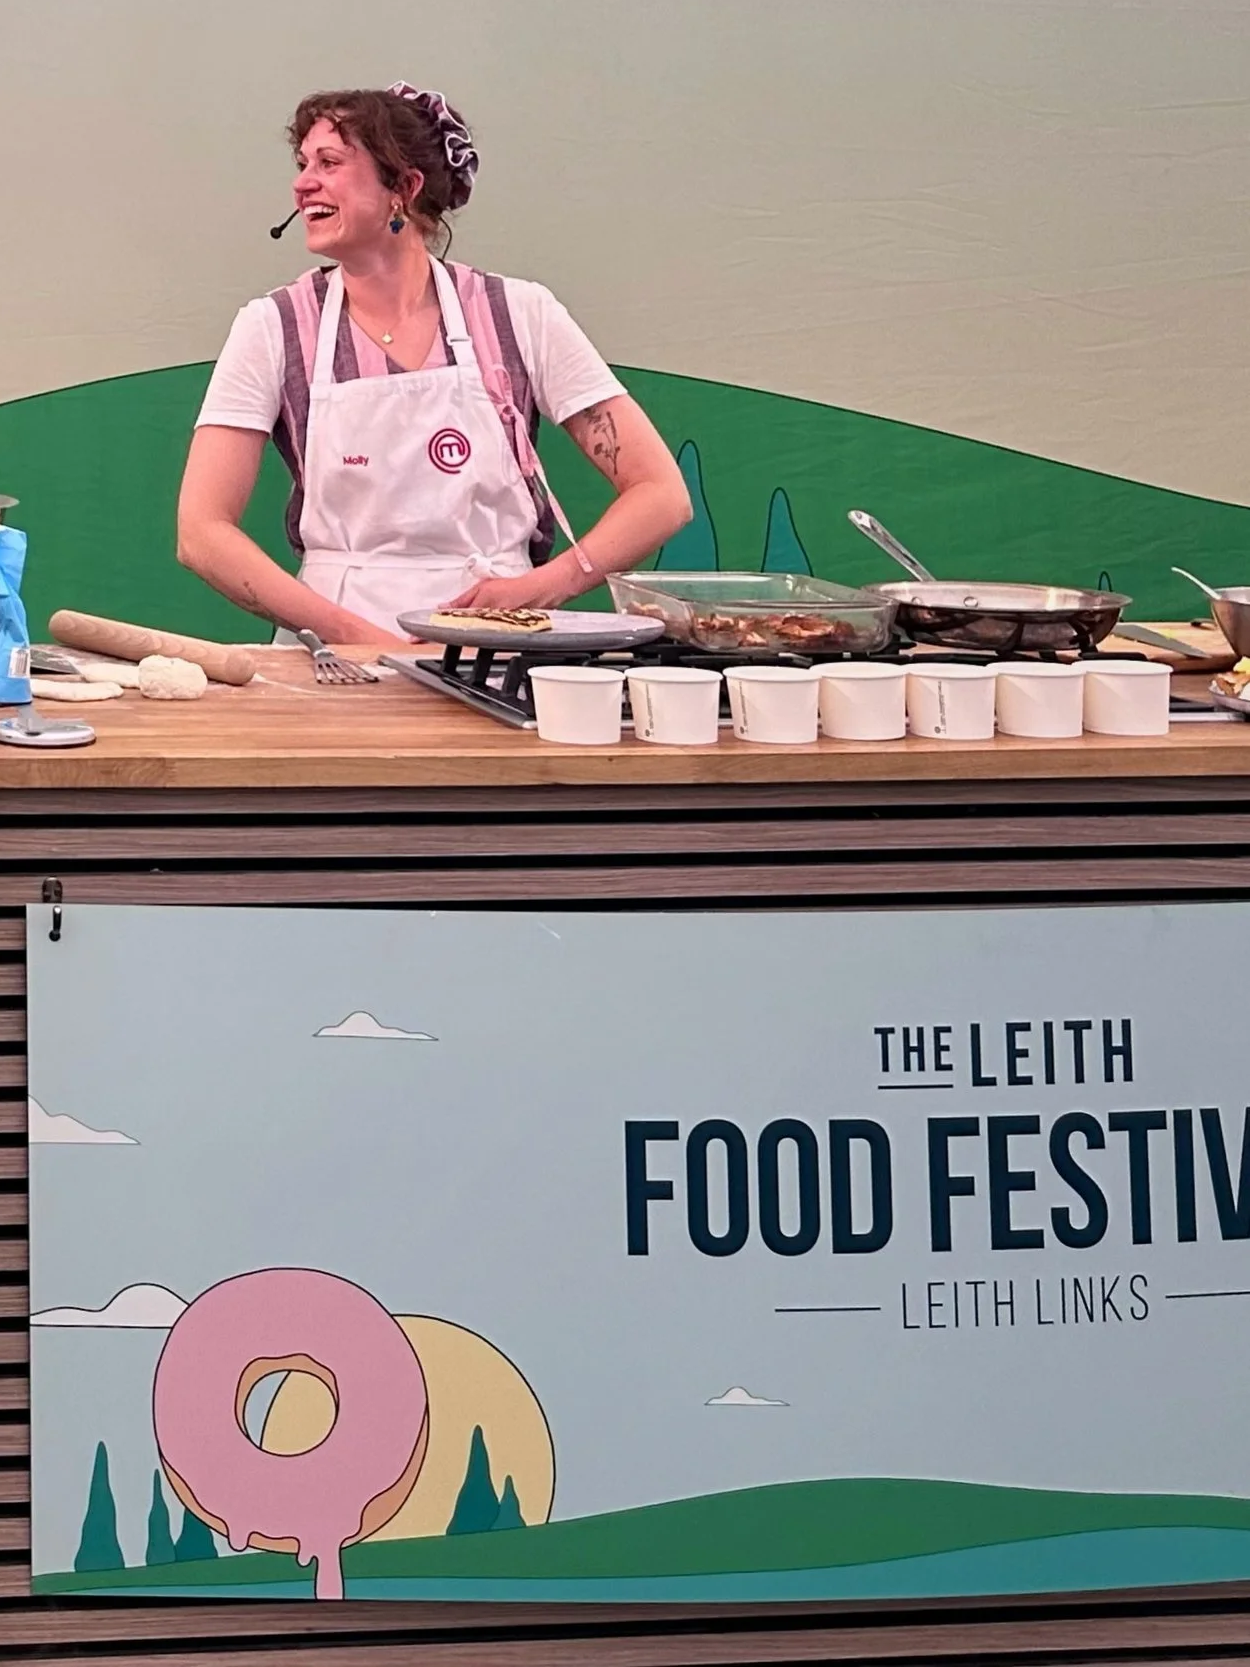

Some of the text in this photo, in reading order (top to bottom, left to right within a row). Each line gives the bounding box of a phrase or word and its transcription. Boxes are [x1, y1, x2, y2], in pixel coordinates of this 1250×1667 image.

[342, 455, 370, 467] Molly
[874, 1018, 1134, 1087] THE LEITH
[624, 1118, 893, 1257] FOOD
[902, 1274, 1149, 1329] LEITH LINKS
